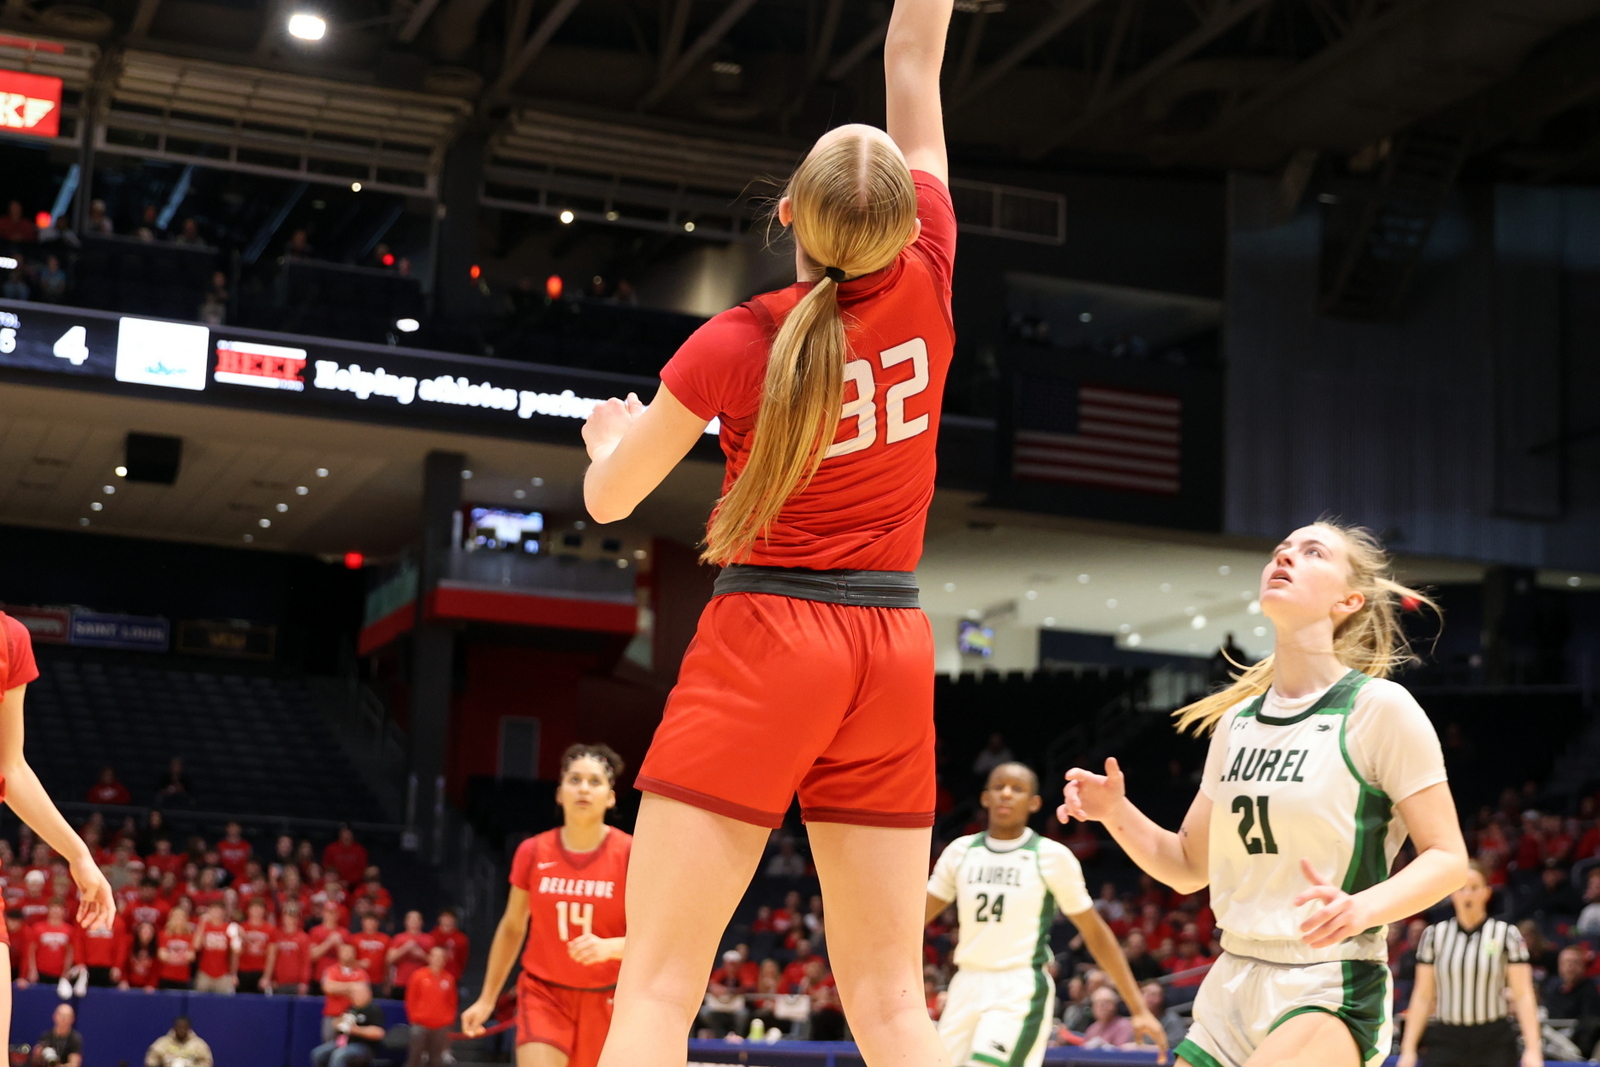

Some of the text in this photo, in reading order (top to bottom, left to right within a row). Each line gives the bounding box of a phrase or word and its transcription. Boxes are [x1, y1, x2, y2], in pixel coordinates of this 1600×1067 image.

[53, 325, 89, 366] 4
[314, 360, 417, 404] Helping
[419, 375, 518, 411] athletes
[1220, 747, 1309, 783] AUREL
[1231, 794, 1279, 856] 21
[538, 876, 615, 900] BELLEVUE
[966, 865, 1022, 887] LAUREL
[555, 901, 594, 942] 14
[976, 892, 1005, 923] 24
